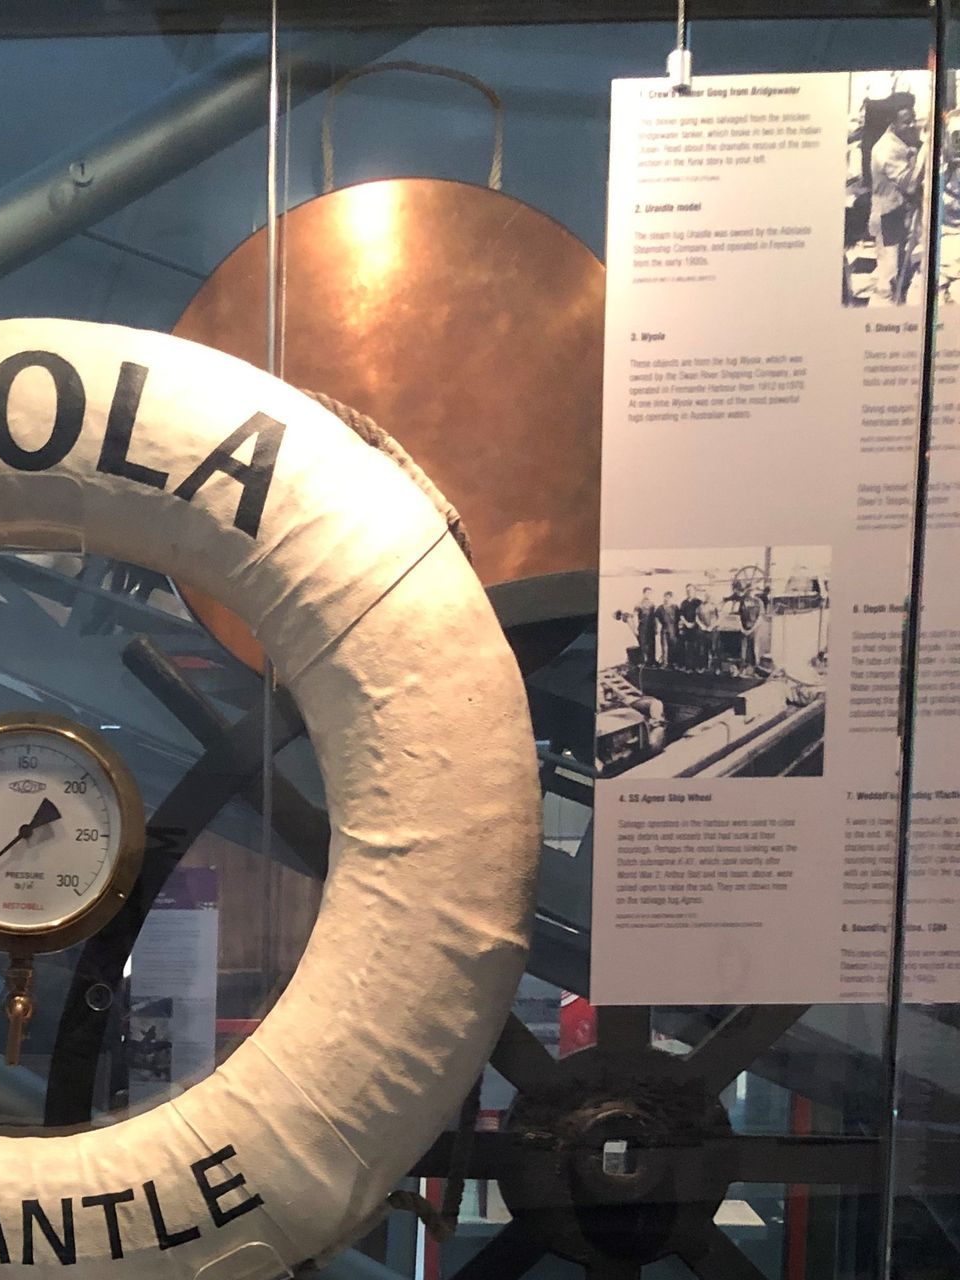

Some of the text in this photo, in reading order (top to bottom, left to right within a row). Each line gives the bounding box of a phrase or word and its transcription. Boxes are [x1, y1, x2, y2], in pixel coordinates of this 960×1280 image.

[18, 756, 39, 769] 150
[64, 781, 87, 794] 200
[75, 828, 99, 841] 250
[5, 871, 45, 880] PRESSURE
[56, 874, 80, 888] 300
